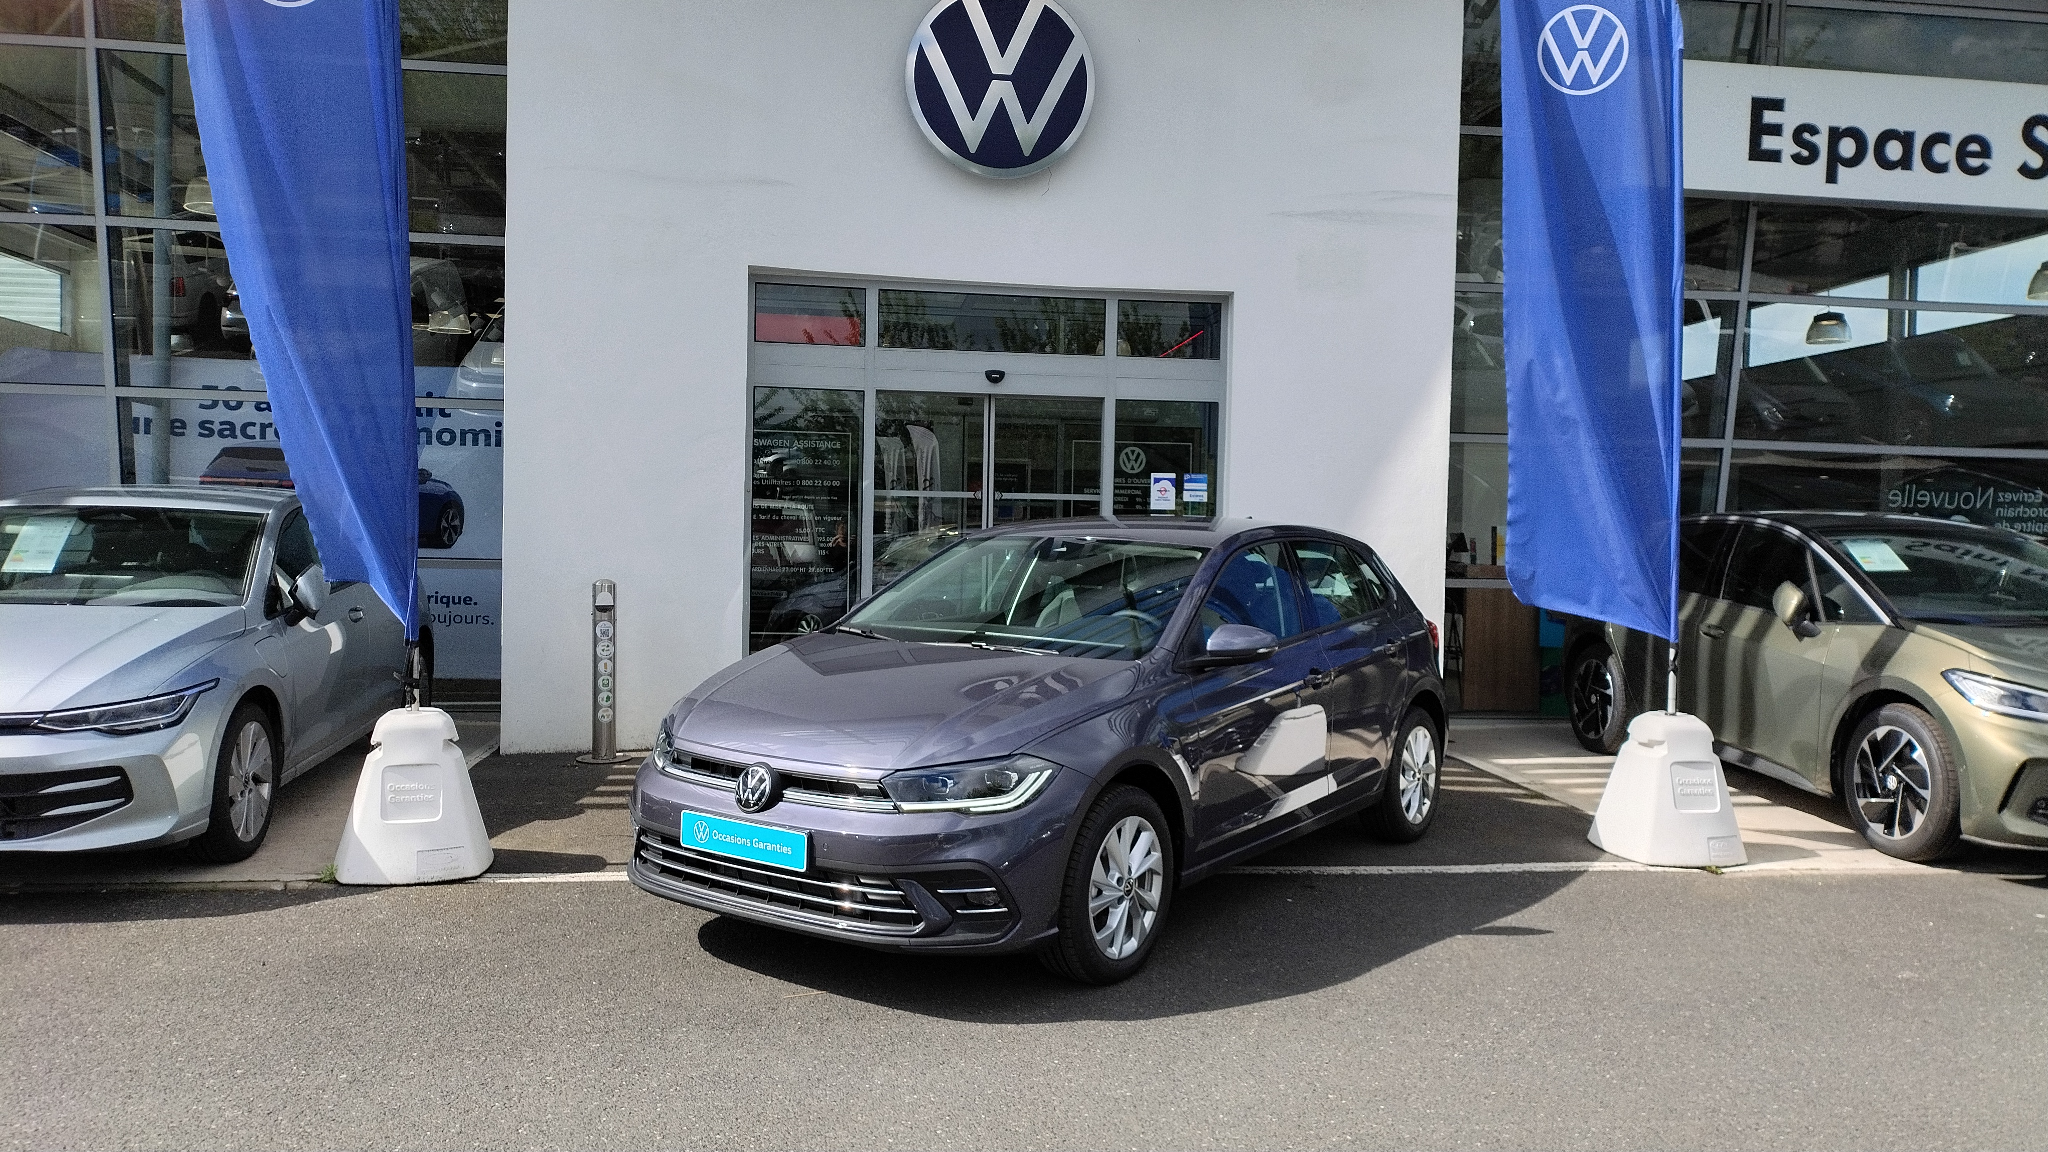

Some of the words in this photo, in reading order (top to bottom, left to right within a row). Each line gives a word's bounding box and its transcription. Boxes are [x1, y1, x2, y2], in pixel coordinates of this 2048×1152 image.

[1537, 4, 1629, 95] VW
[1748, 96, 1993, 184] Espace
[793, 440, 841, 449] ASSISTANCE
[1119, 447, 1146, 474] VW
[427, 591, 478, 608] rique.
[693, 820, 710, 843] VW
[712, 830, 750, 847] Occasions
[752, 838, 792, 855] Garanties
